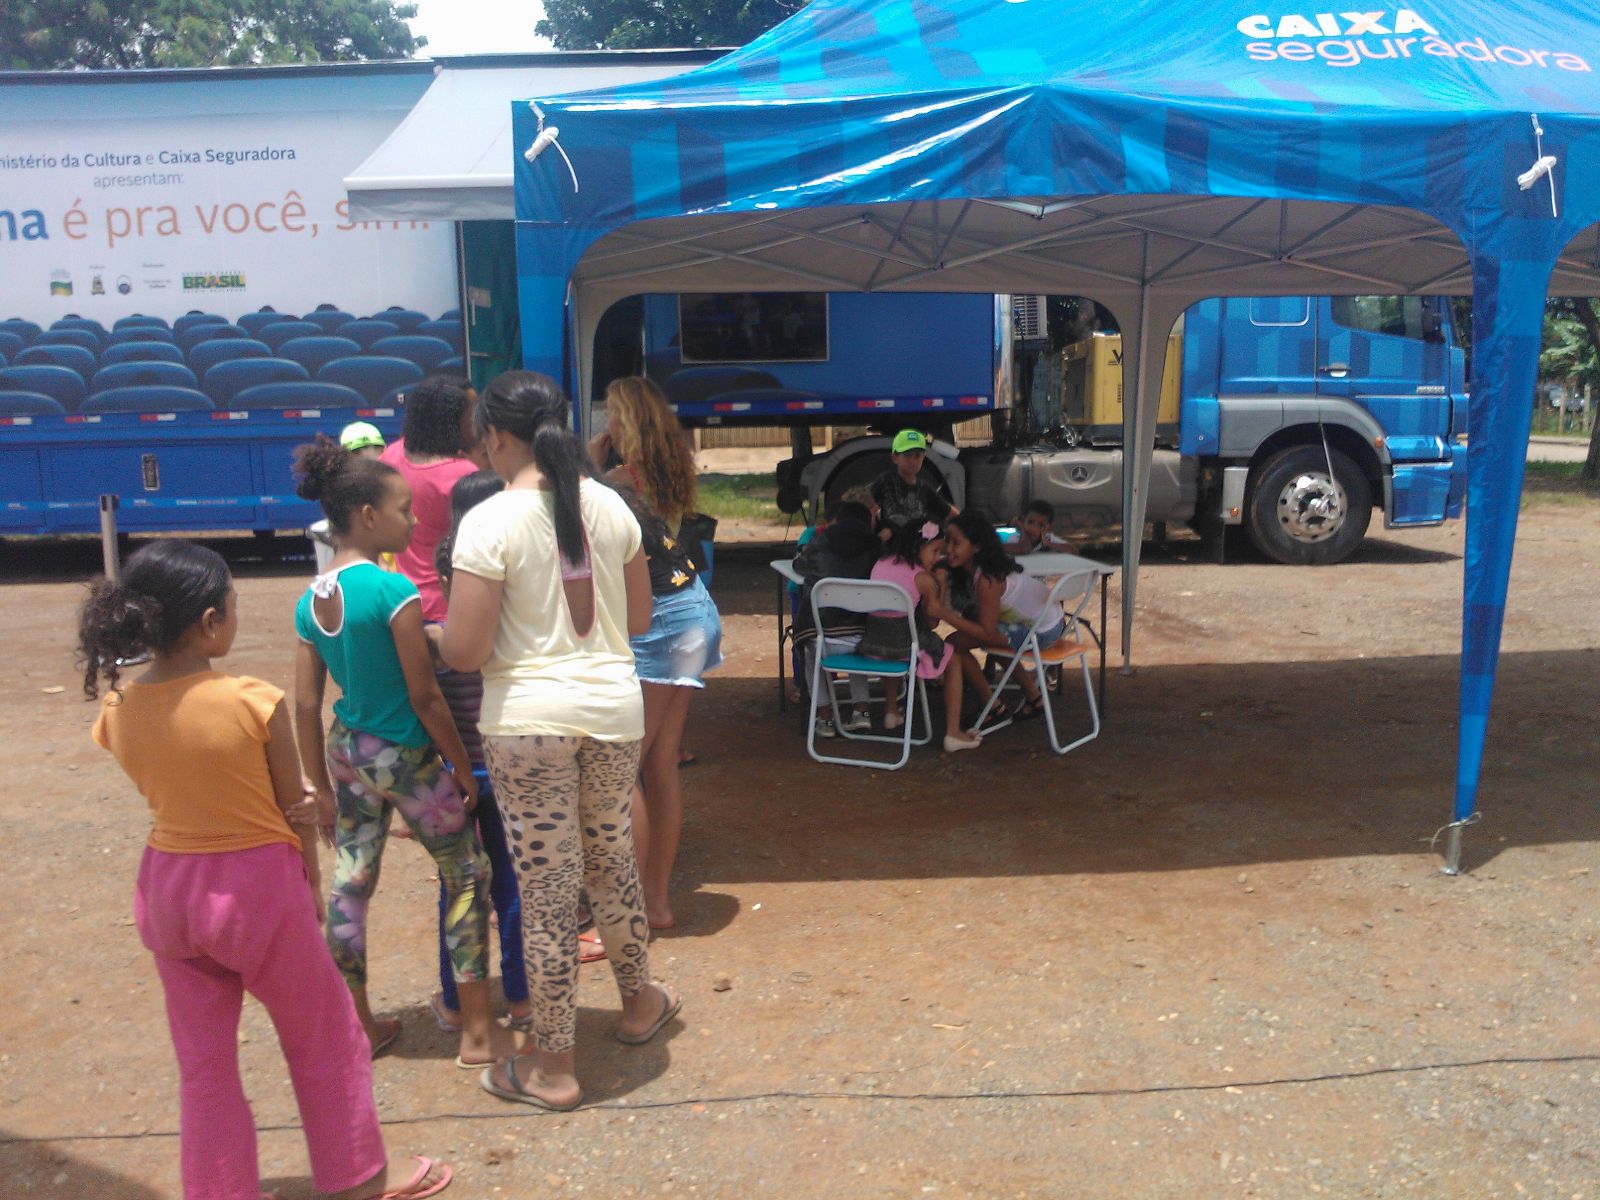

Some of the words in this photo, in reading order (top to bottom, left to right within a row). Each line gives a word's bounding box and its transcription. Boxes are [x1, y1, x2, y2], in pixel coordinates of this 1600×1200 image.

[1236, 9, 1440, 39] CAIXA
[1245, 34, 1593, 73] seguradora
[61, 153, 80, 168] da
[84, 152, 142, 168] Cultura
[145, 154, 154, 166] e
[158, 149, 202, 166] Caixa
[205, 147, 297, 163] Seguradora
[93, 173, 185, 190] apresentam:
[63, 197, 88, 241] é
[105, 203, 182, 249] pra
[194, 190, 320, 239] você,
[182, 274, 246, 290] BRASIL
